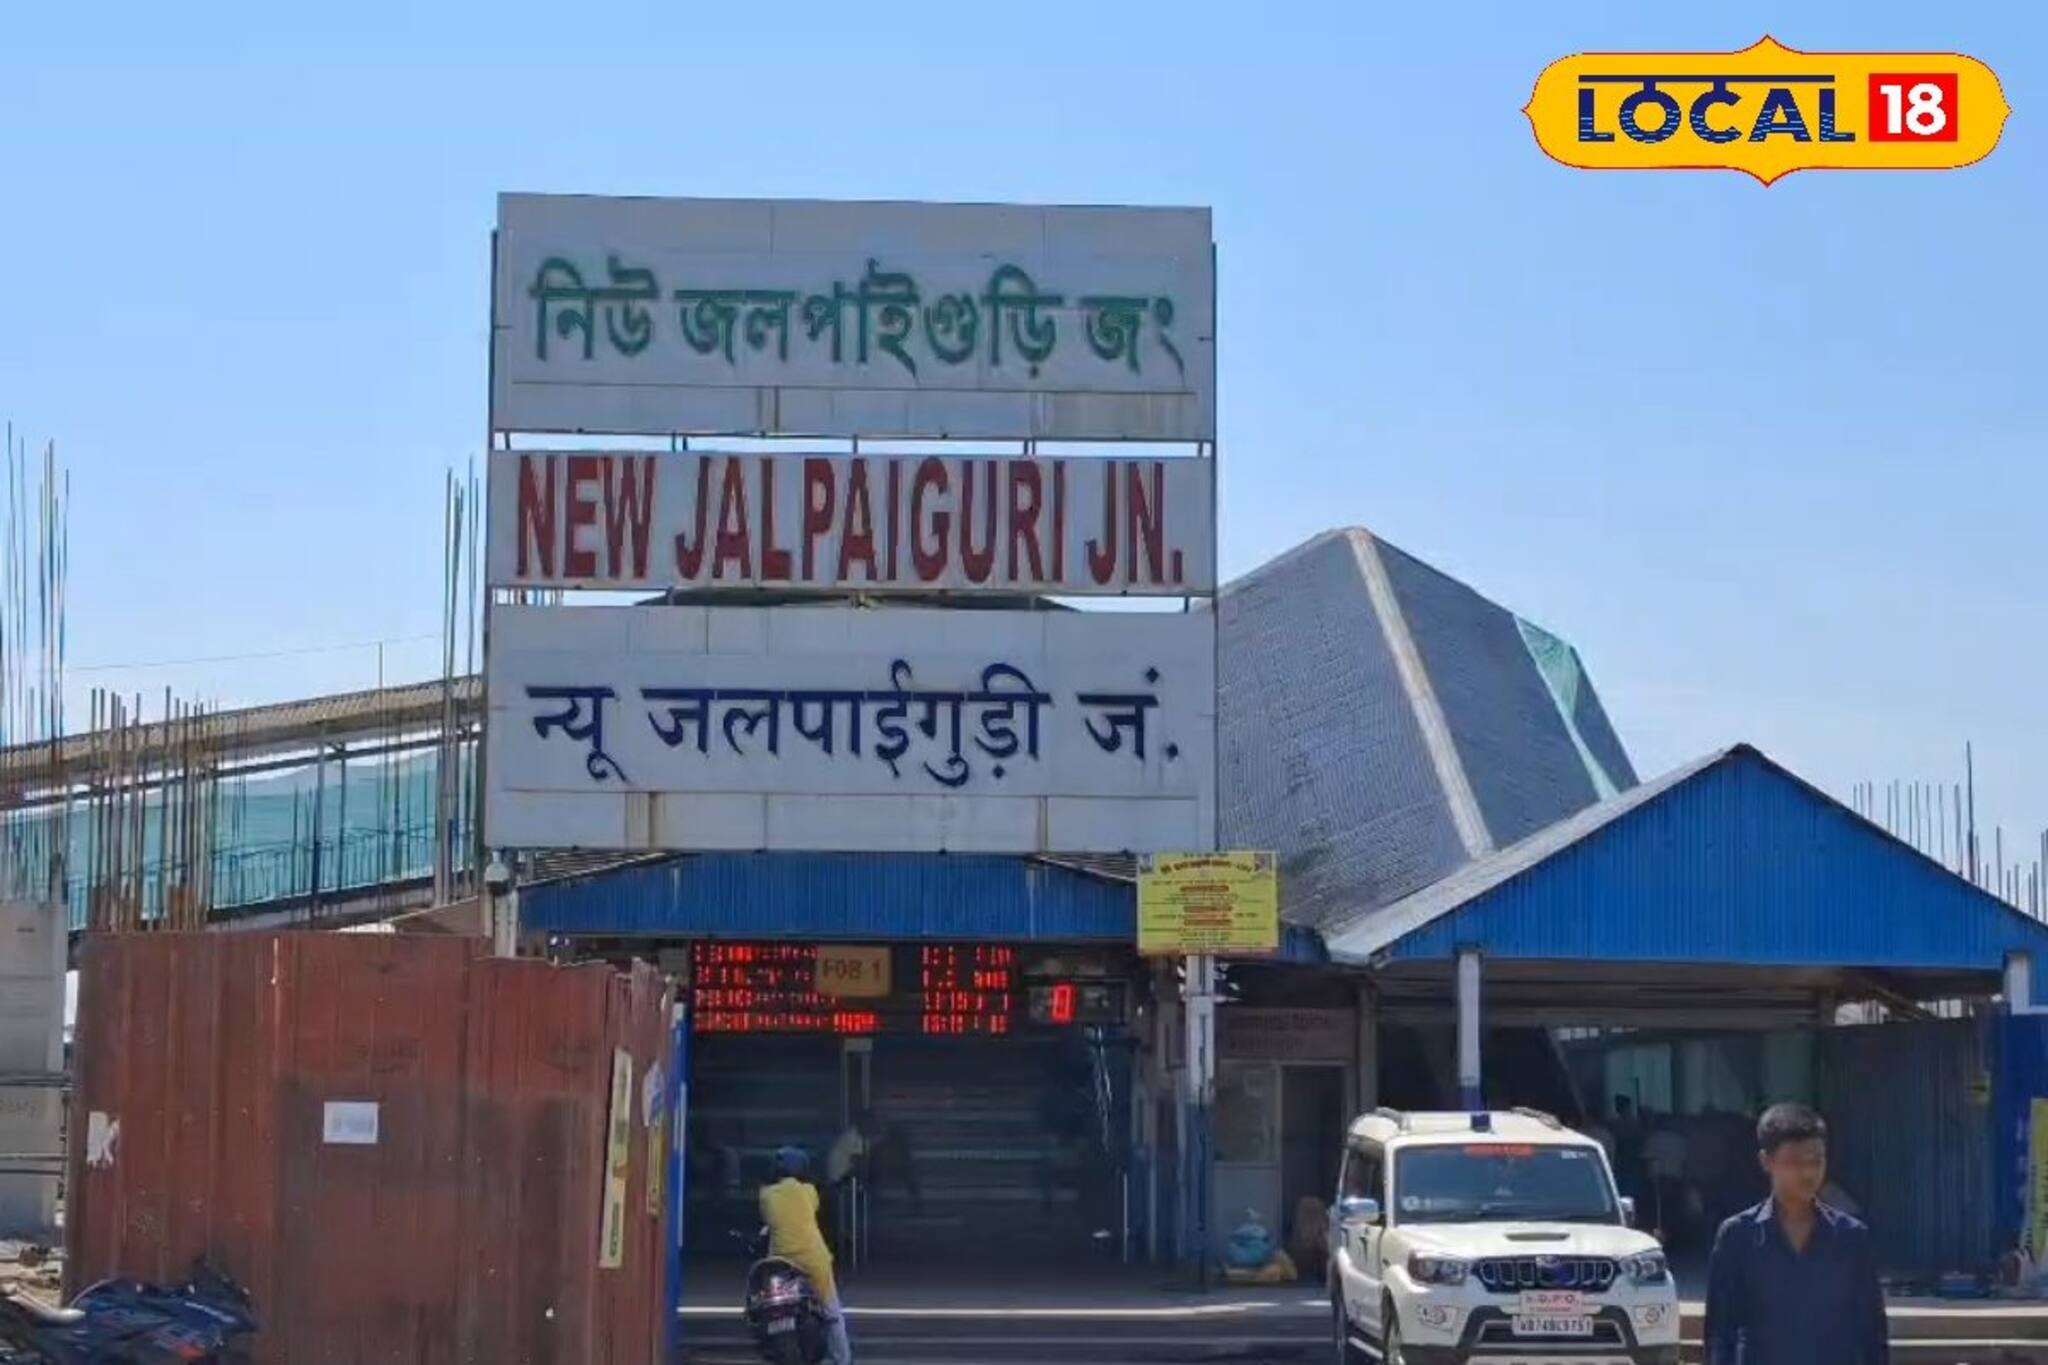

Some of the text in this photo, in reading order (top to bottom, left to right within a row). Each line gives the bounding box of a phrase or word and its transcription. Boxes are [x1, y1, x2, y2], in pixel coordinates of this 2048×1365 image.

[528, 255, 1185, 378] নিউ জলপাইগুড়ি জং
[516, 455, 1184, 585] NEW JALPAIGURI JN.
[525, 659, 1180, 787] न्यू जलपाईगुड़ी जं.
